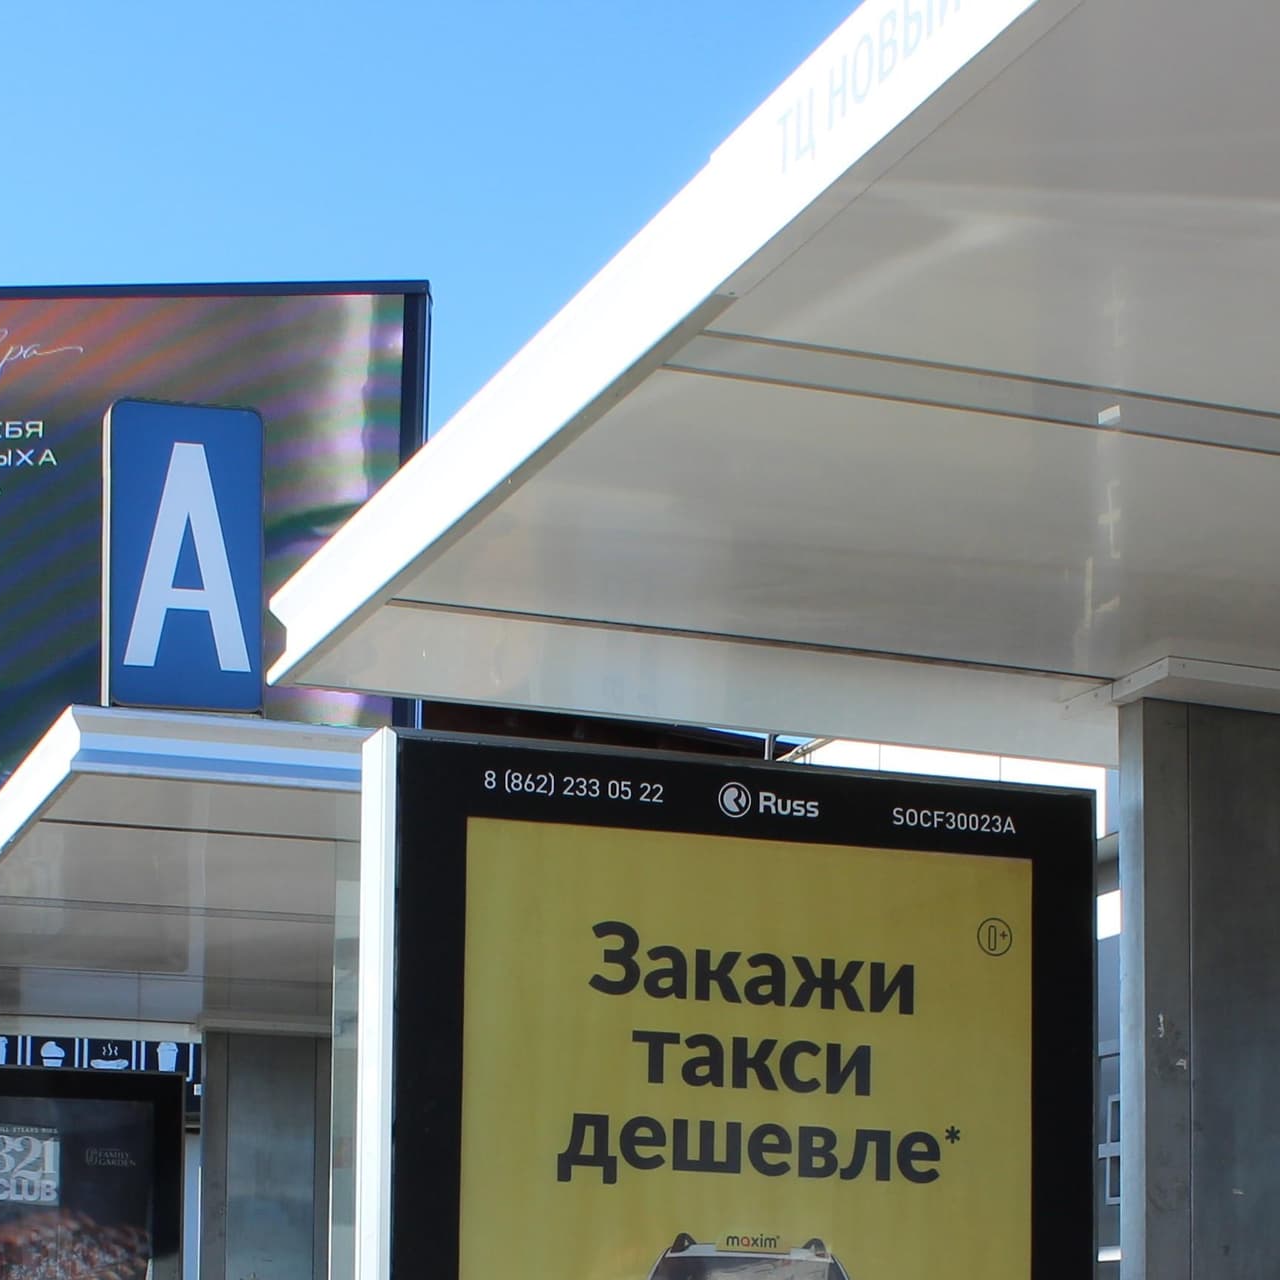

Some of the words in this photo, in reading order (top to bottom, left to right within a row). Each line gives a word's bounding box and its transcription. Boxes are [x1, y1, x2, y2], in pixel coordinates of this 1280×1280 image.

[483, 769, 497, 790] 8
[504, 770, 556, 797] (862)
[562, 775, 601, 799] 233
[607, 780, 633, 801] 05
[639, 782, 664, 803] 22
[758, 791, 820, 819] Russ
[891, 807, 1017, 835] SOCF30023A
[588, 920, 916, 1016] Закажи
[632, 1029, 872, 1098] такси
